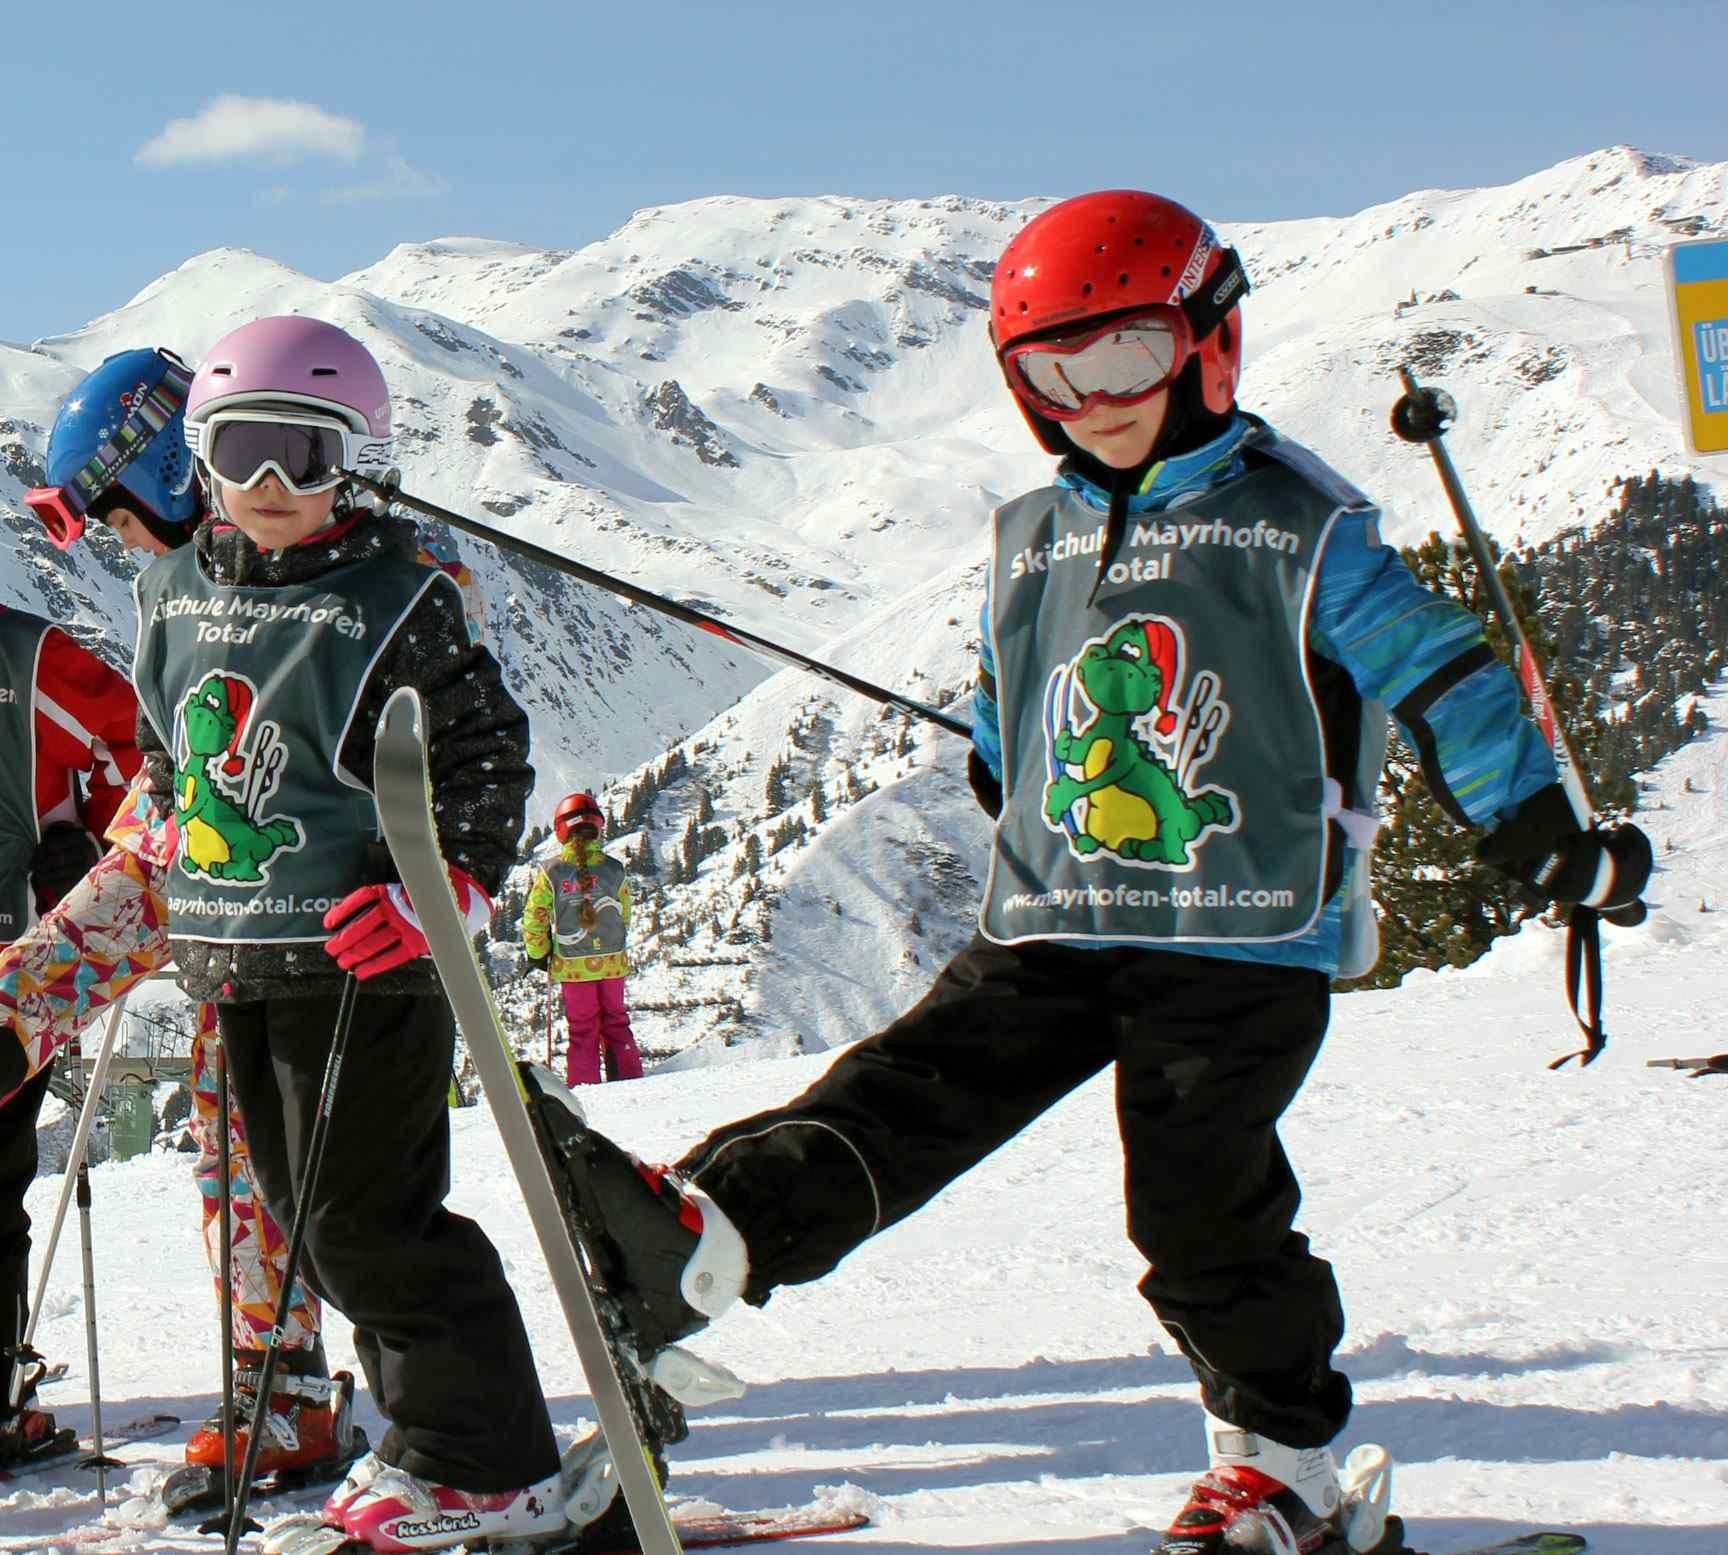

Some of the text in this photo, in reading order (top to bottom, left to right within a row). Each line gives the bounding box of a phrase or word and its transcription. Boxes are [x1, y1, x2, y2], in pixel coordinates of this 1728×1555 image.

[1130, 518, 1300, 554] Mayrhofen
[197, 621, 258, 644] Total
[227, 594, 367, 640] Mayrhofen
